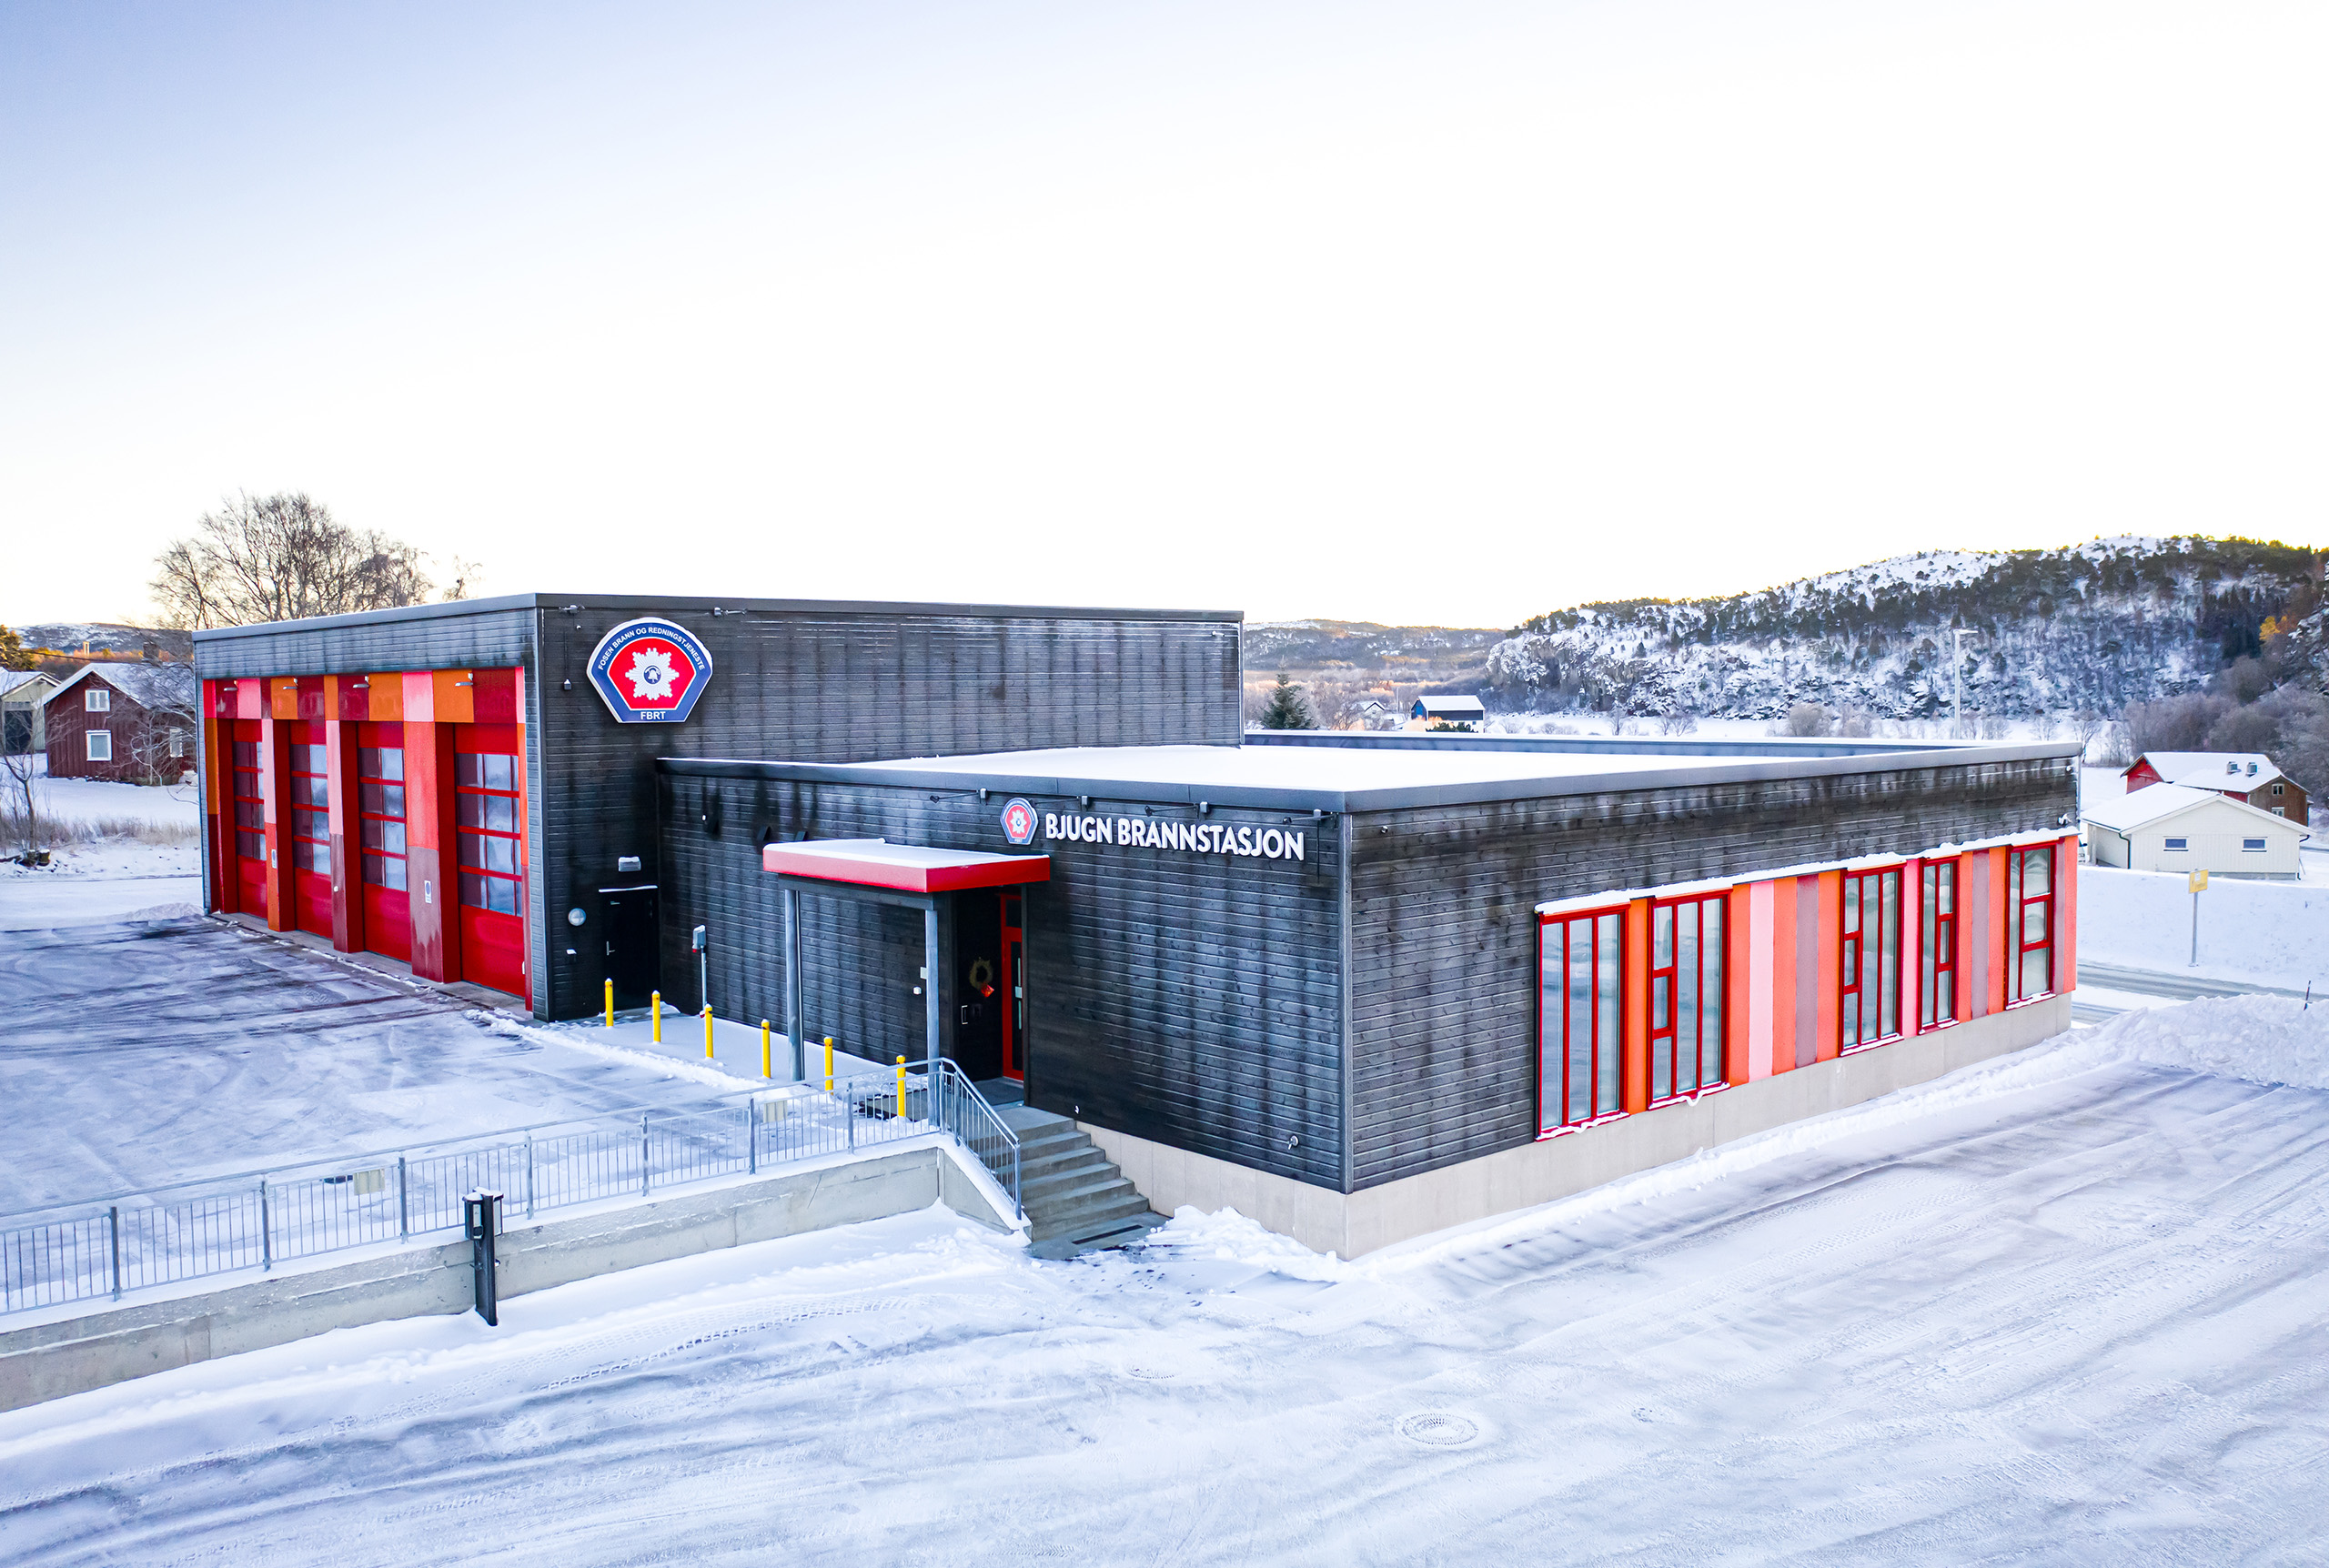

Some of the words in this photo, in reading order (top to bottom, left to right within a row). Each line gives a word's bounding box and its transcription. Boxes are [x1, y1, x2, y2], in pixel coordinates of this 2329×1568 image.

[598, 646, 614, 670] FOSEN
[612, 630, 635, 648] BRANN
[648, 627, 705, 670] REDNINGSTJENESTE
[640, 711, 666, 720] FBRT
[1045, 813, 1113, 844] BJUGN
[1118, 818, 1305, 860] BRANNSTASJON
